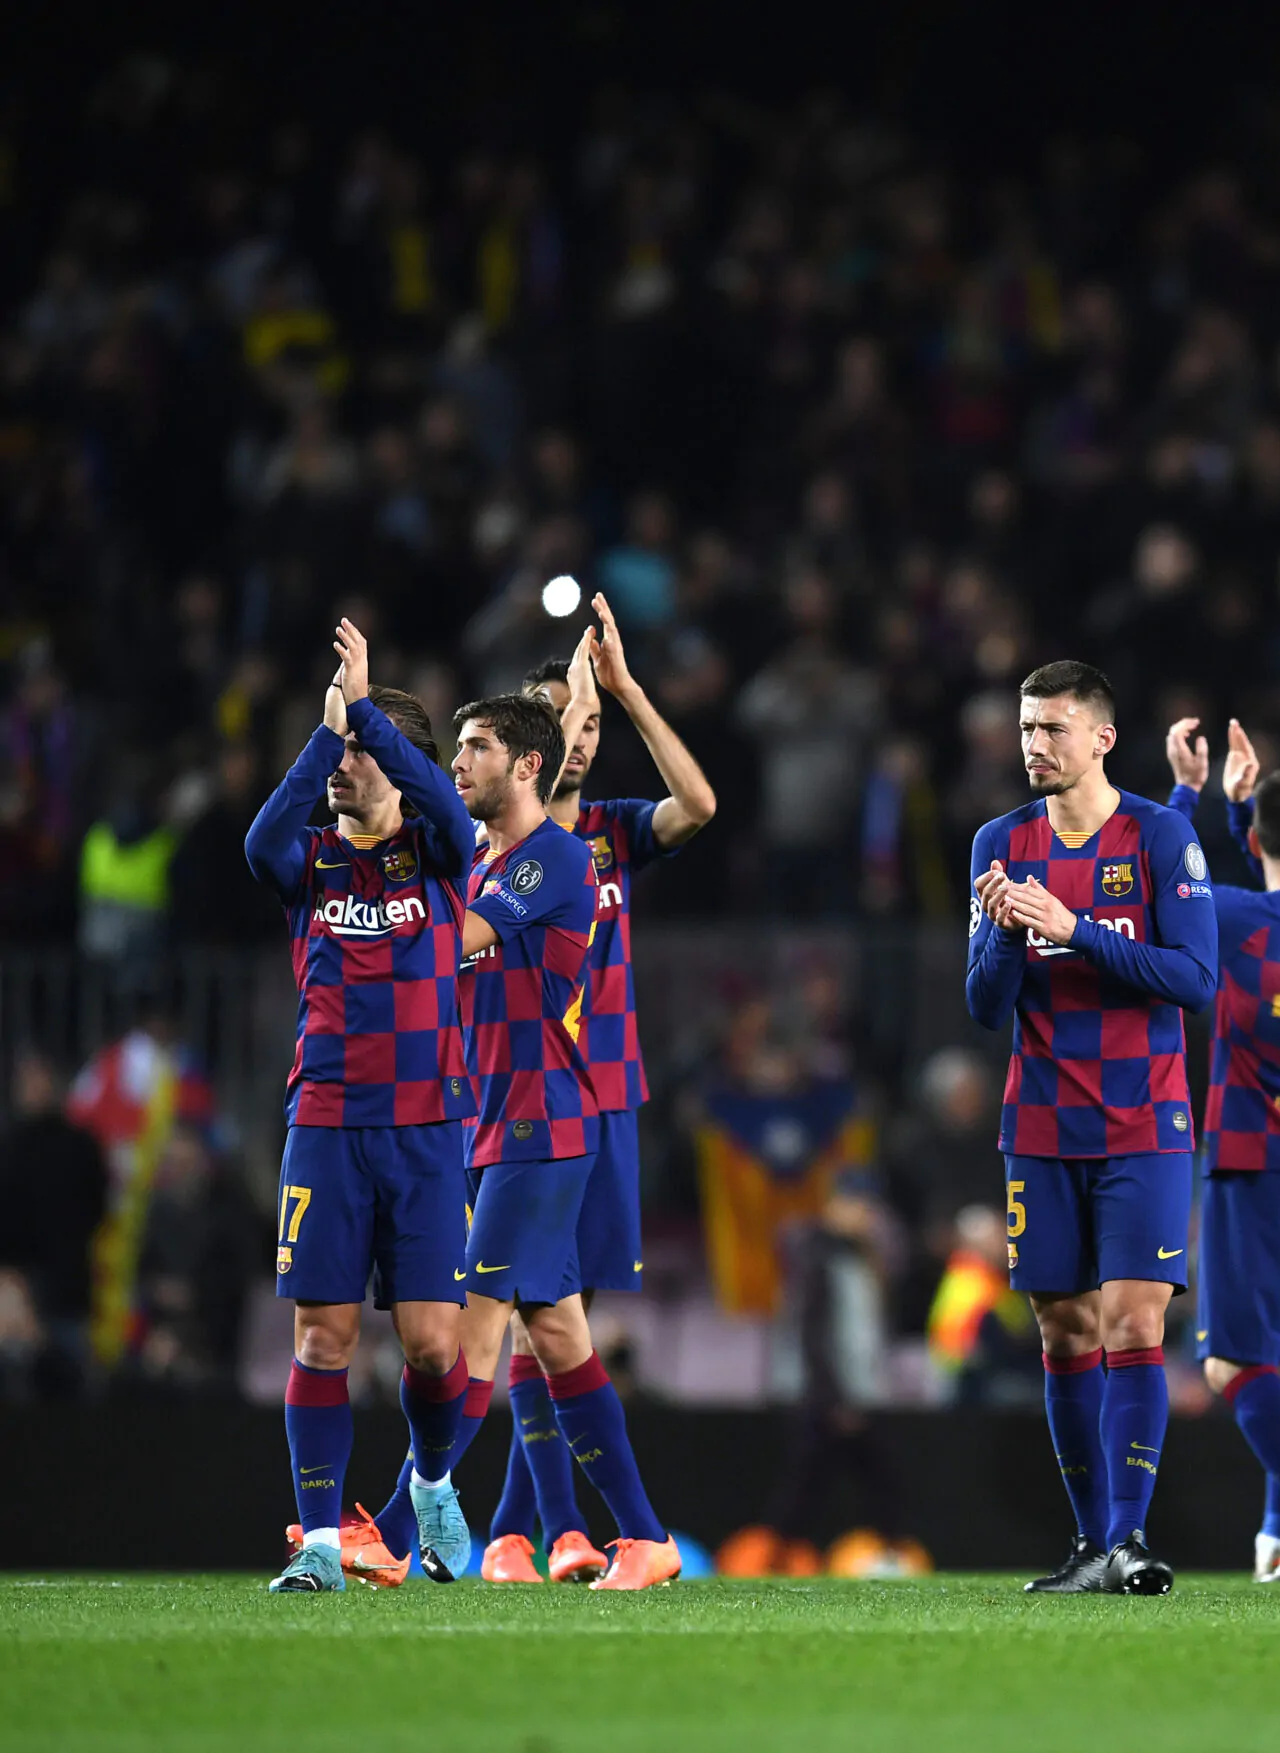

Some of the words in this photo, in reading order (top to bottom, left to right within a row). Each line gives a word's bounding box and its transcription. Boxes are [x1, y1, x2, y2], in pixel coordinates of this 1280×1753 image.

[313, 892, 426, 929] Rakuten
[499, 889, 528, 917] RESPECT
[279, 1185, 312, 1243] 17
[301, 1478, 336, 1490] BARÇA
